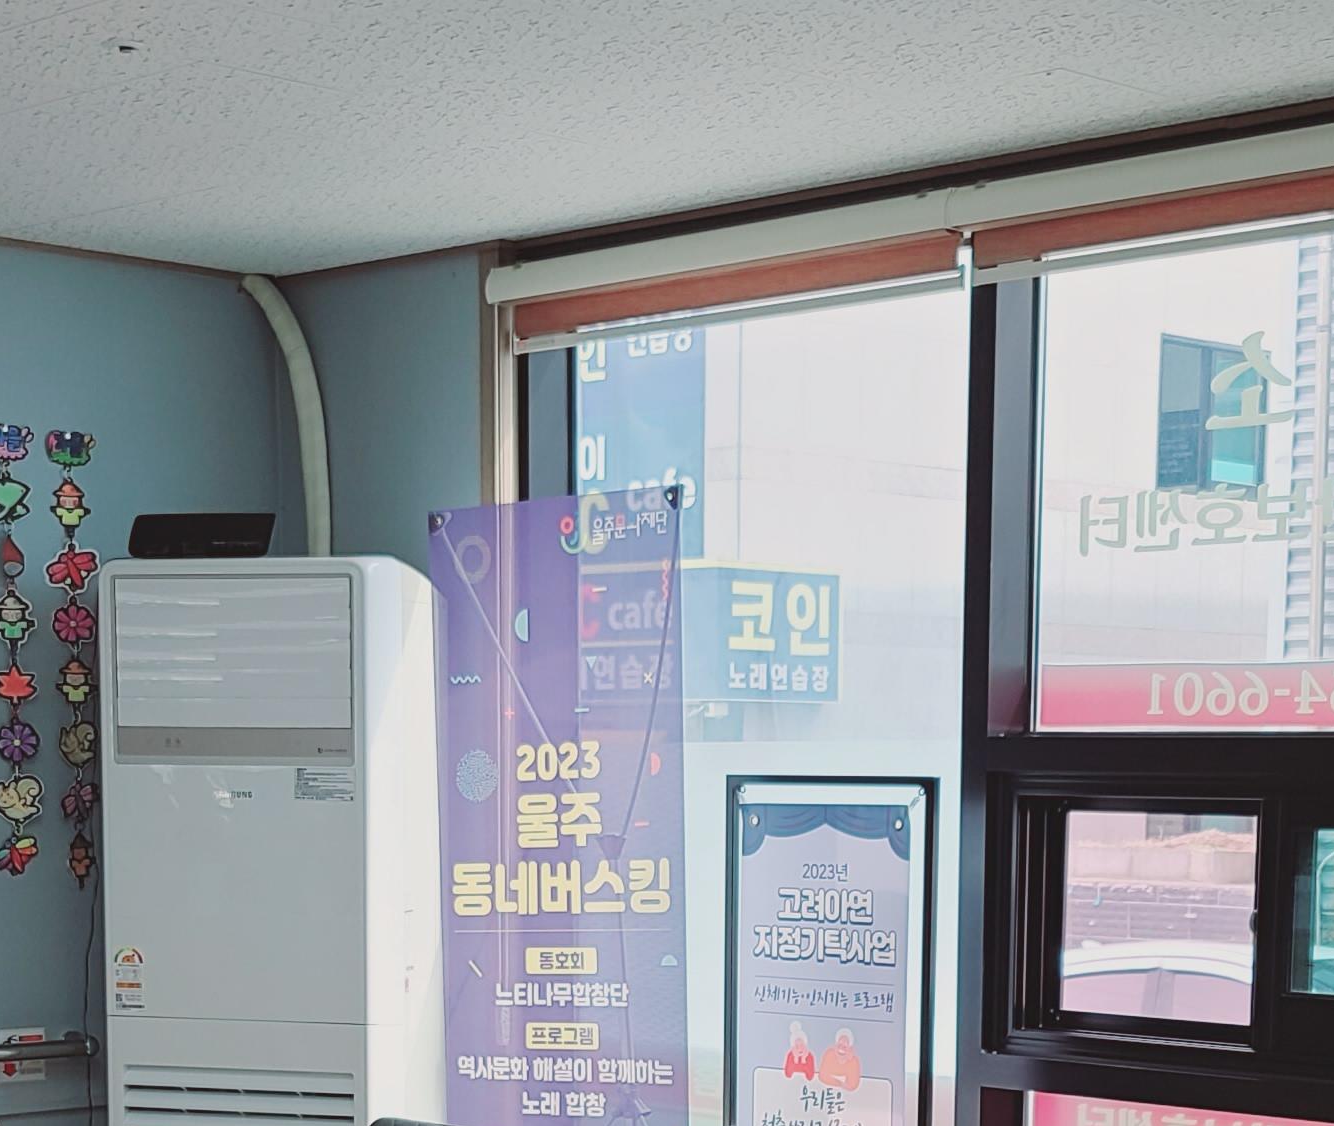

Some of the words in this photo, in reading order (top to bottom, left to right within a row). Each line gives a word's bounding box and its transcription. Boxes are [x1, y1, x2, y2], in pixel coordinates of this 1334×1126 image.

[729, 580, 830, 656] 코인
[728, 661, 829, 692] 노래연습장
[516, 740, 601, 782] 2023
[517, 791, 603, 849] 울주
[452, 857, 671, 917] 동네버스킹
[802, 863, 848, 882] 2023년
[777, 887, 874, 925] 고려아연
[539, 951, 585, 970] 동호회
[752, 925, 897, 967] 지정기탁사업
[495, 982, 629, 1007] 느티나무합창단
[853, 991, 894, 1013] 프로그램
[531, 1027, 594, 1046] 프로그램
[458, 1056, 529, 1081] 역사문화
[532, 1057, 593, 1082] 해설이
[598, 1059, 674, 1085] 함께하는
[522, 1091, 560, 1116] 노래
[565, 1092, 606, 1117] 합창
[800, 1085, 845, 1114] 우리들은
